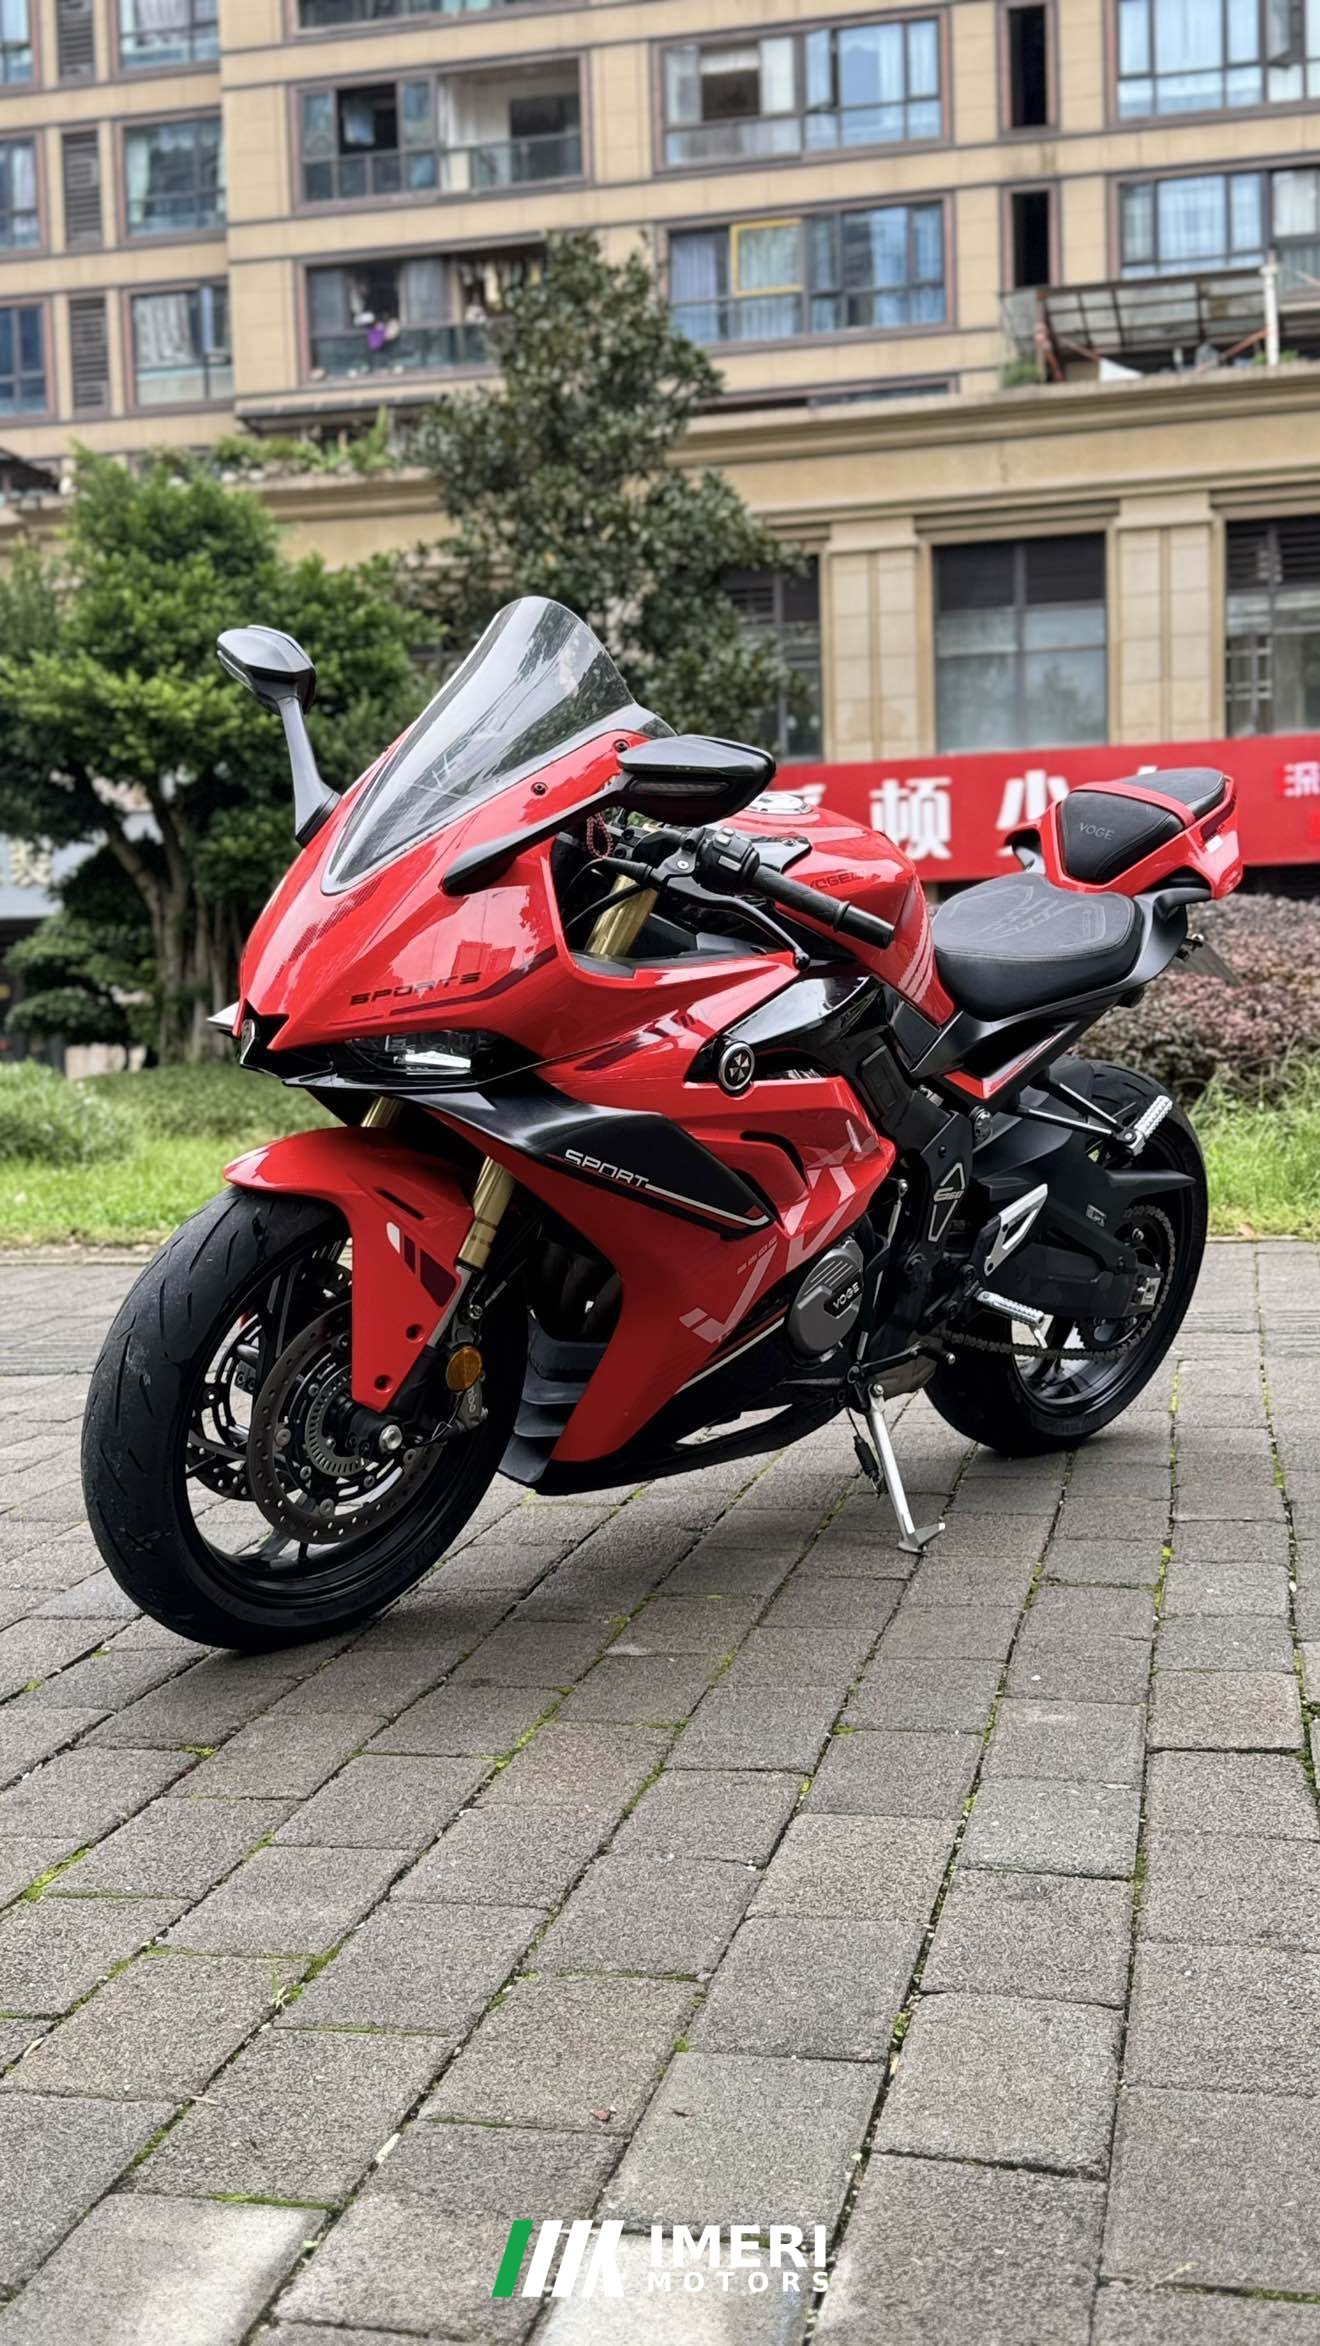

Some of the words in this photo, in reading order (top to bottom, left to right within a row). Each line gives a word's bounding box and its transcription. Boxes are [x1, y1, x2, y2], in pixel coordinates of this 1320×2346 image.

[1080, 822, 1115, 841] VOGE
[350, 972, 482, 1005] SPORTS
[565, 1149, 649, 1187] SPORT
[832, 1282, 860, 1310] VOGE
